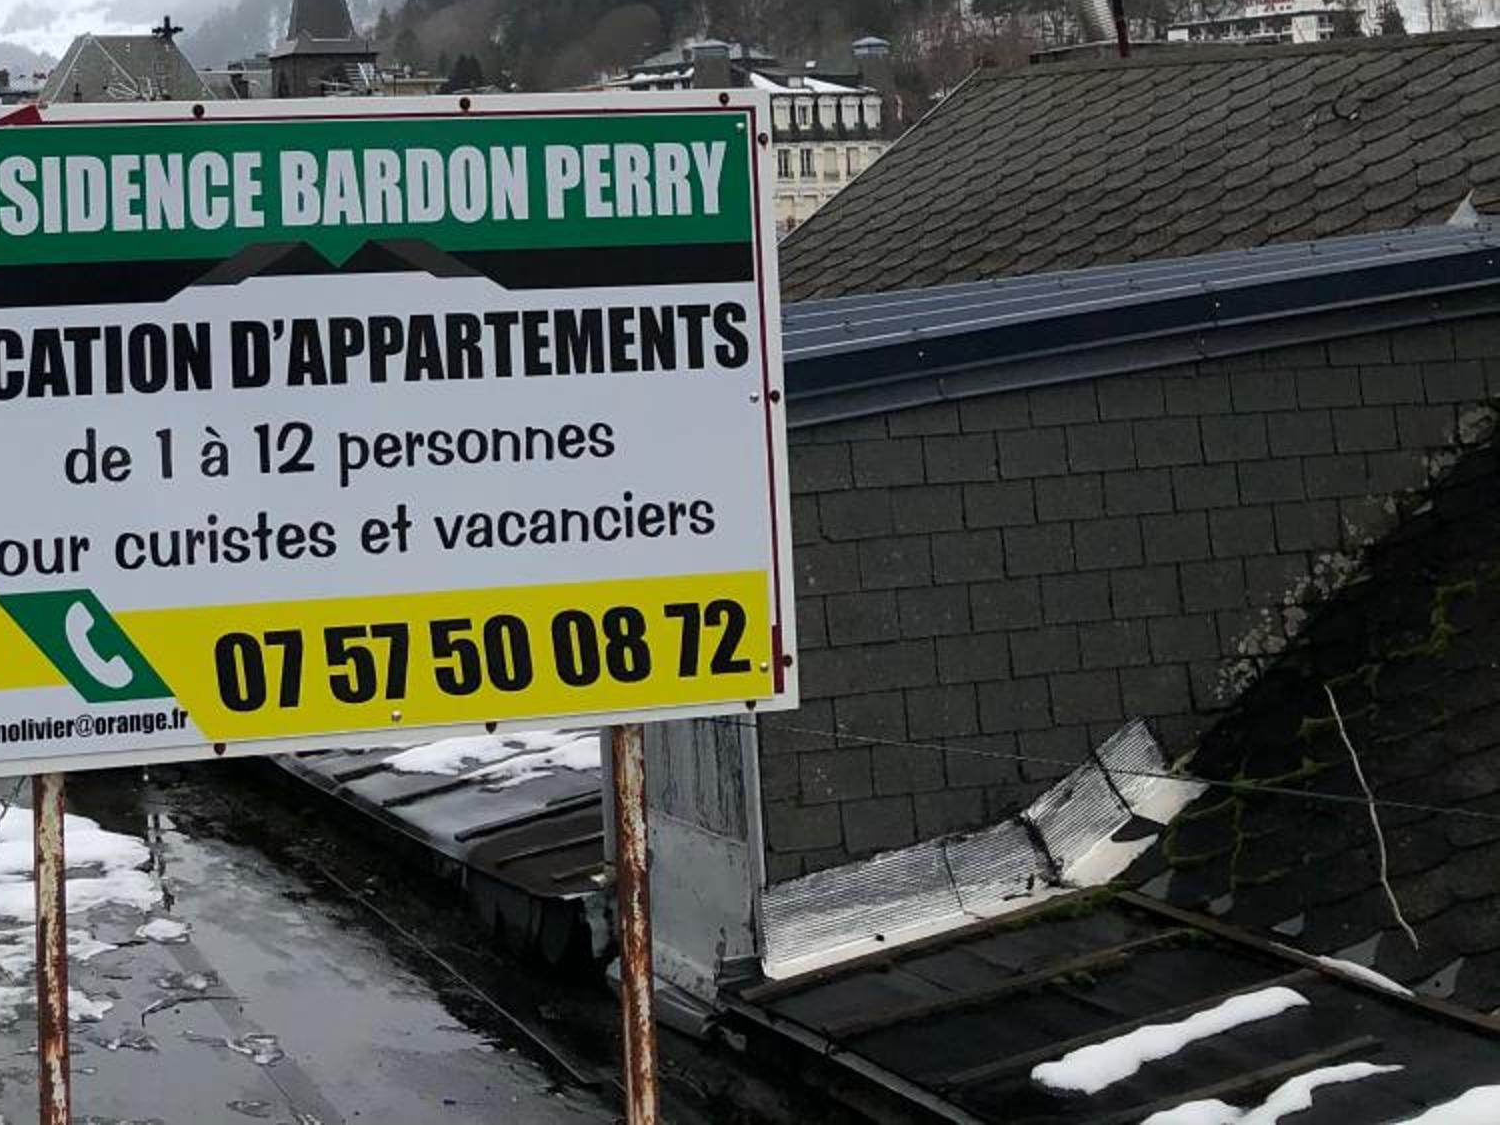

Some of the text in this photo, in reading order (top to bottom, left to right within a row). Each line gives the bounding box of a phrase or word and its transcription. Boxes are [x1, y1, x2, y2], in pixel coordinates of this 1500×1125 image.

[280, 145, 529, 226] BARDON
[545, 141, 726, 220] PERRY
[230, 301, 750, 389] D'APPARTEMENTS
[65, 421, 615, 488] de 1 à 12 personnes
[115, 511, 337, 570] curistes
[361, 504, 413, 555] et
[433, 490, 715, 550] vacanciers
[214, 598, 752, 713] 07 57 50 08 72
